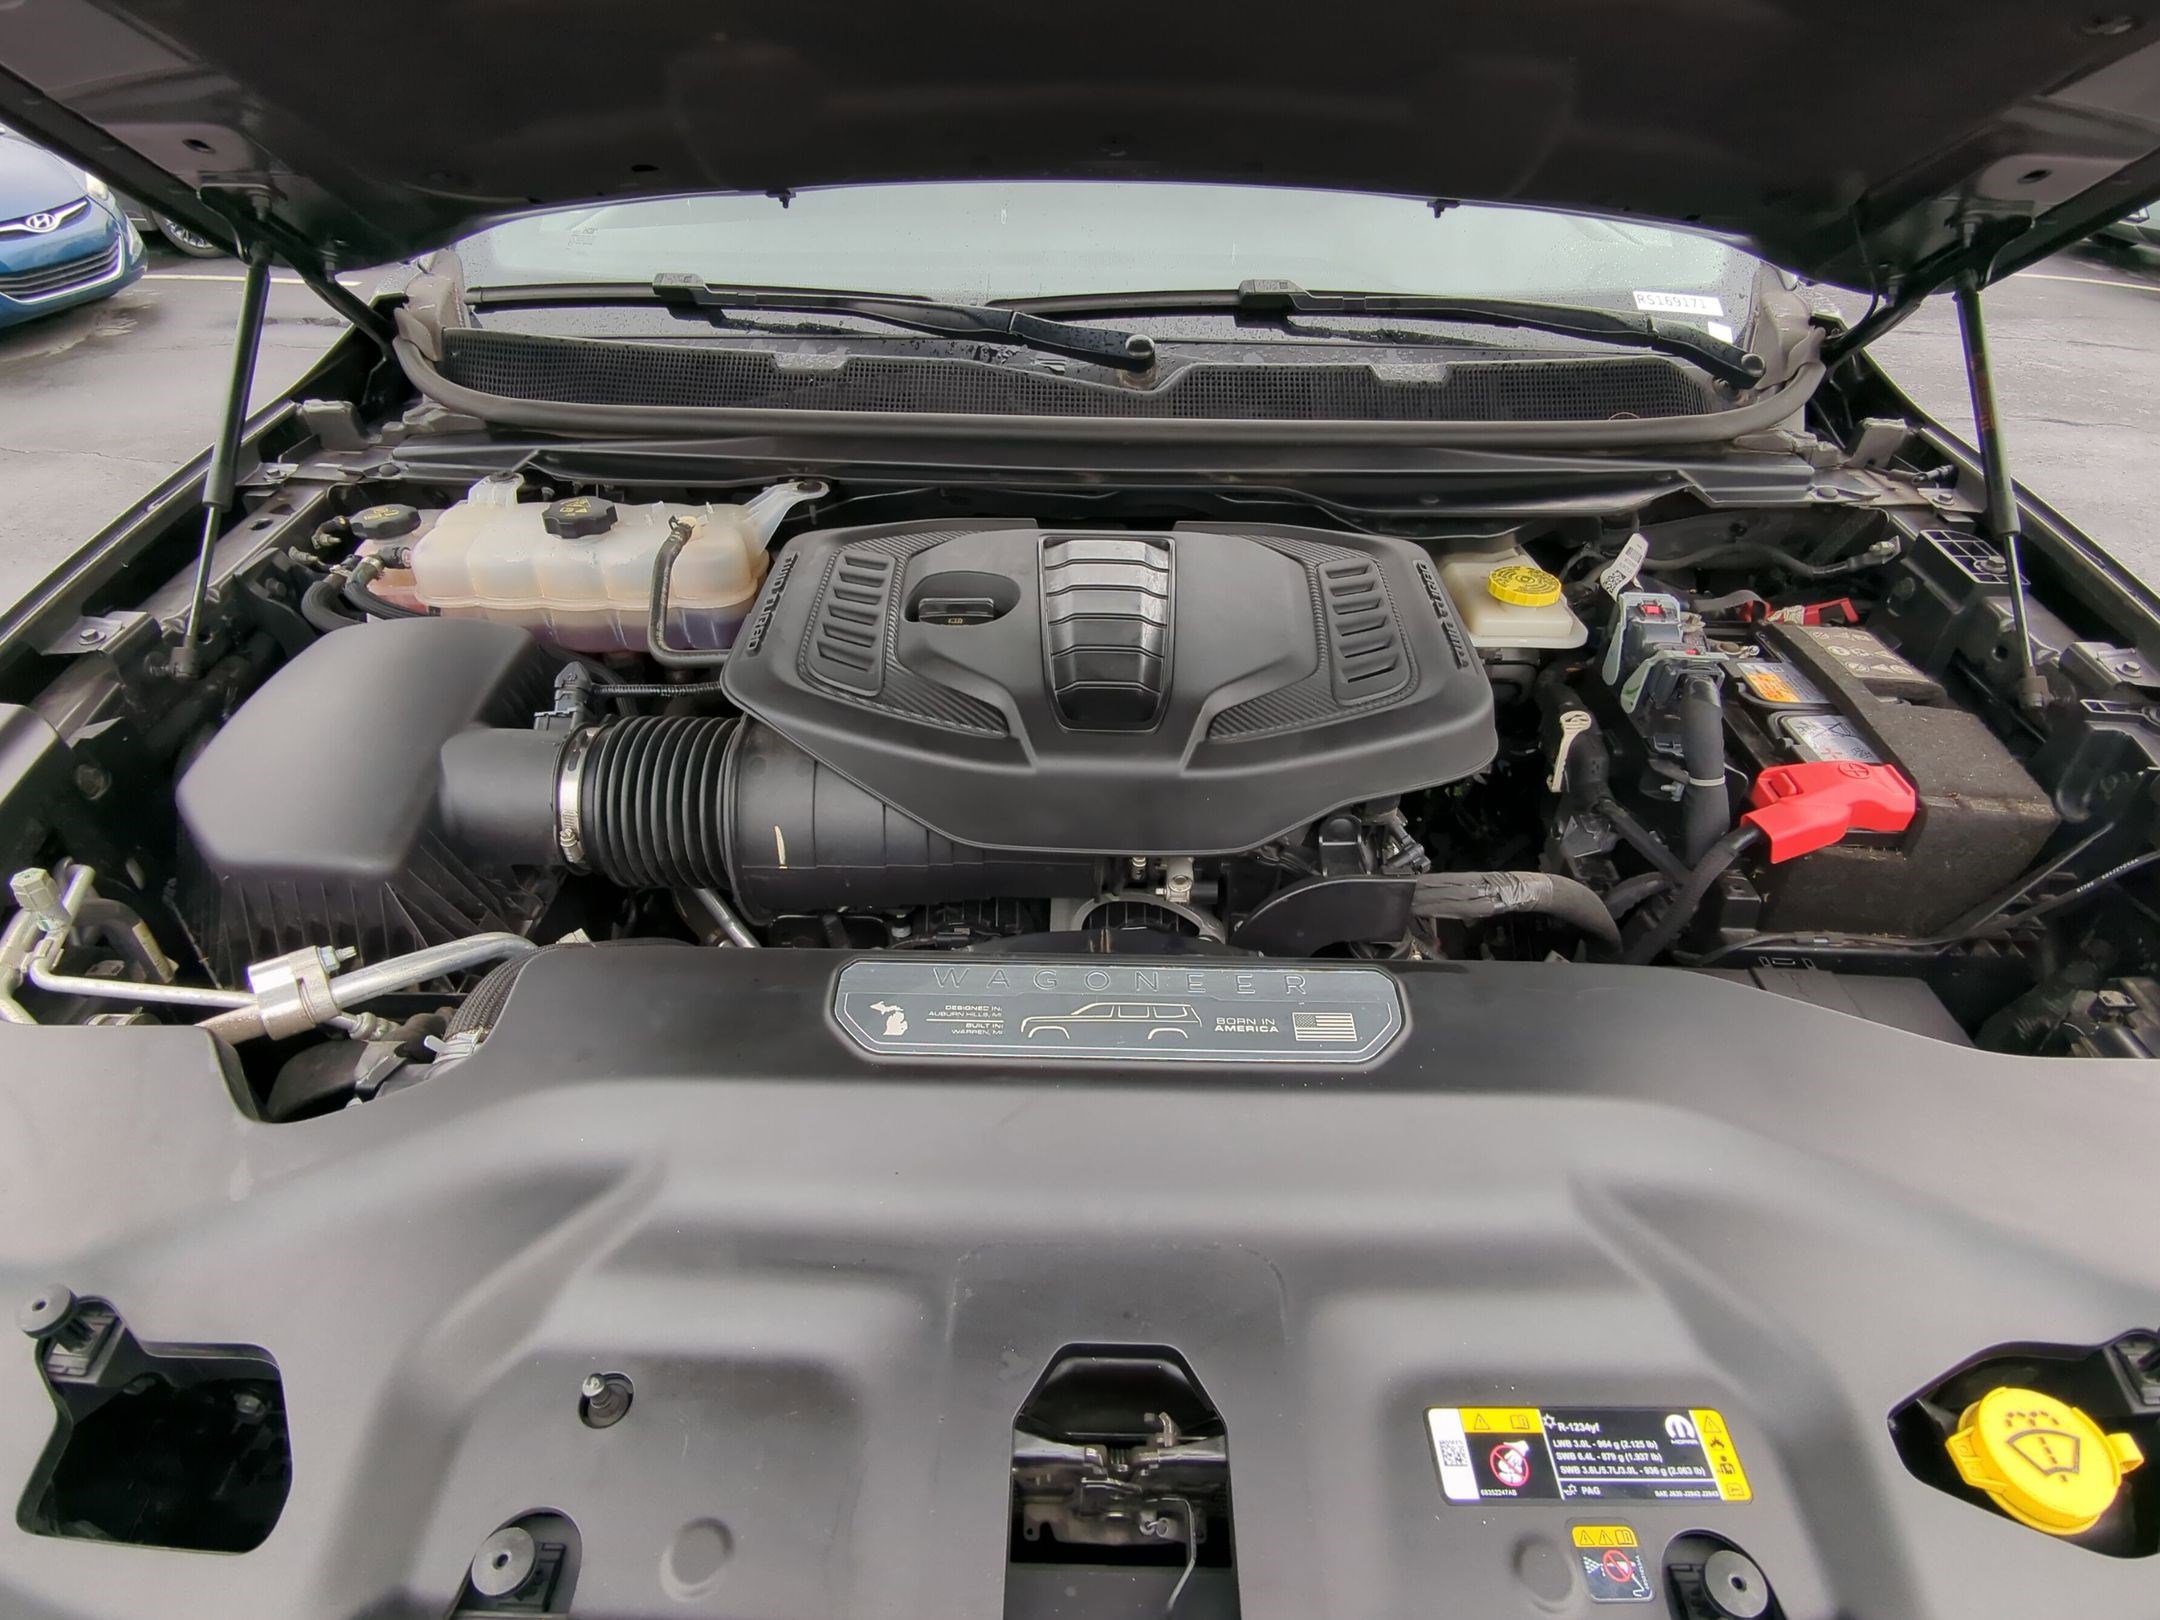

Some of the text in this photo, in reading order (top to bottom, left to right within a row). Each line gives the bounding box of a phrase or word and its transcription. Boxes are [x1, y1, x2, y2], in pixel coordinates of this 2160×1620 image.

[747, 590, 781, 651] TURBO
[932, 967, 1307, 995] WAGONEER
[1216, 1017, 1256, 1025] BORN
[1215, 1025, 1279, 1033] AMERICA
[1581, 1486, 1601, 1495] PAG
